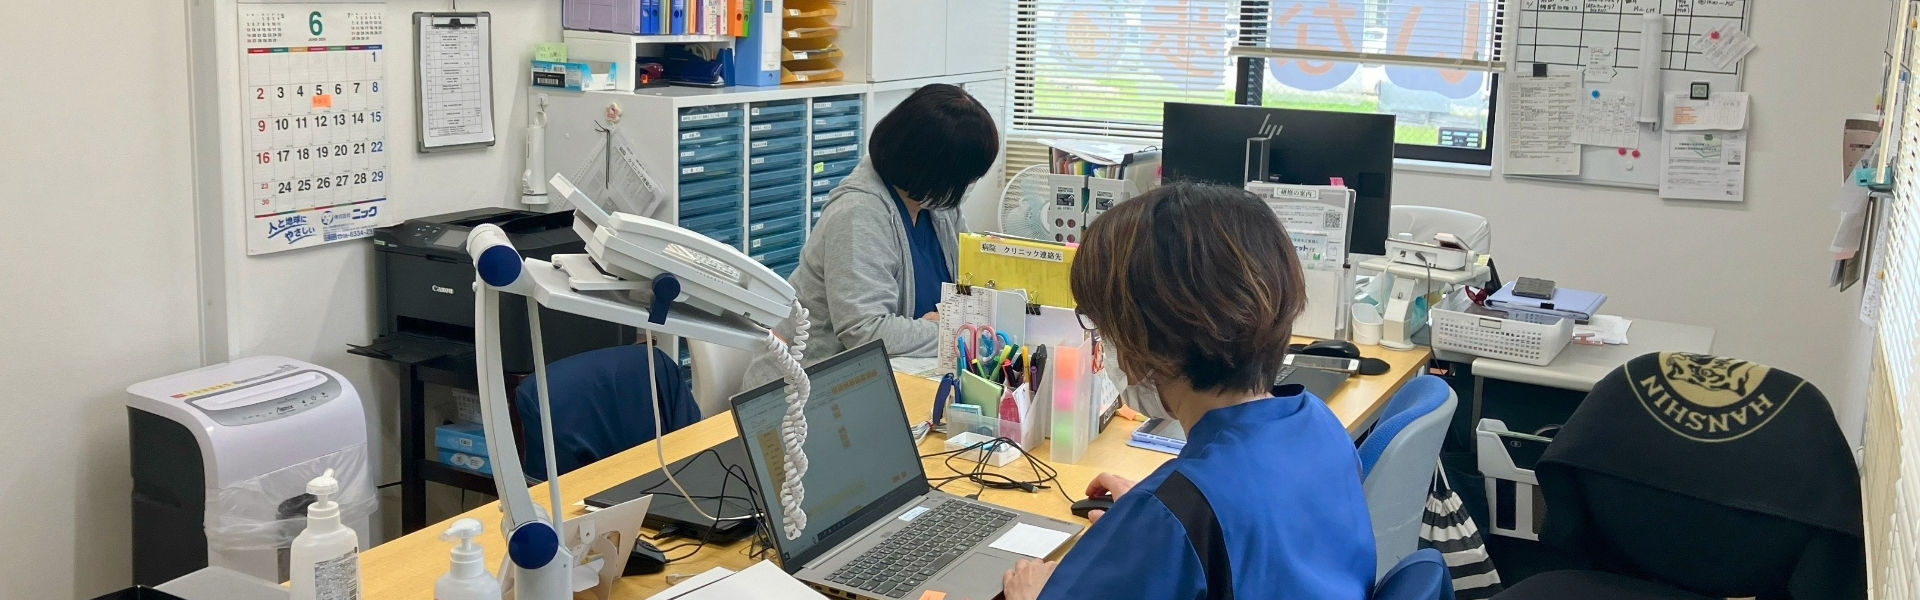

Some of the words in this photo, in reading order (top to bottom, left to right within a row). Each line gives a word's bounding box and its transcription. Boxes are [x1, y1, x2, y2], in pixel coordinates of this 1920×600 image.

[309, 11, 322, 36] 6
[371, 51, 377, 62] 1
[257, 88, 264, 99] 2
[277, 87, 284, 98] 3
[297, 86, 303, 96] 4
[315, 84, 323, 95] 5
[335, 84, 341, 94] 6
[354, 83, 360, 93] 7
[371, 82, 379, 93] 8
[258, 120, 265, 132] 9
[276, 119, 288, 130] 10
[296, 117, 306, 128] 11
[315, 116, 327, 127] 12
[333, 114, 345, 125] 13
[352, 113, 363, 123] 14
[370, 111, 381, 122] 15
[256, 152, 270, 164] 16
[277, 150, 289, 162] 17
[297, 148, 309, 160] 18
[315, 146, 329, 158] 19
[335, 145, 347, 156] 20
[353, 143, 366, 154] 21
[371, 141, 383, 152] 22
[279, 182, 291, 194] 24
[298, 179, 311, 191] 25
[317, 177, 330, 189] 26
[336, 175, 348, 186] 27
[354, 173, 366, 184] 28
[372, 171, 383, 182] 29
[352, 206, 377, 220] ニック
[268, 215, 307, 234] 人と地球に
[285, 227, 315, 241] やさしい
[981, 242, 997, 252] 病院
[1003, 245, 1062, 261] クリニック連絡先
[431, 284, 454, 295] Canon
[1639, 374, 1774, 433] HANSHIN
